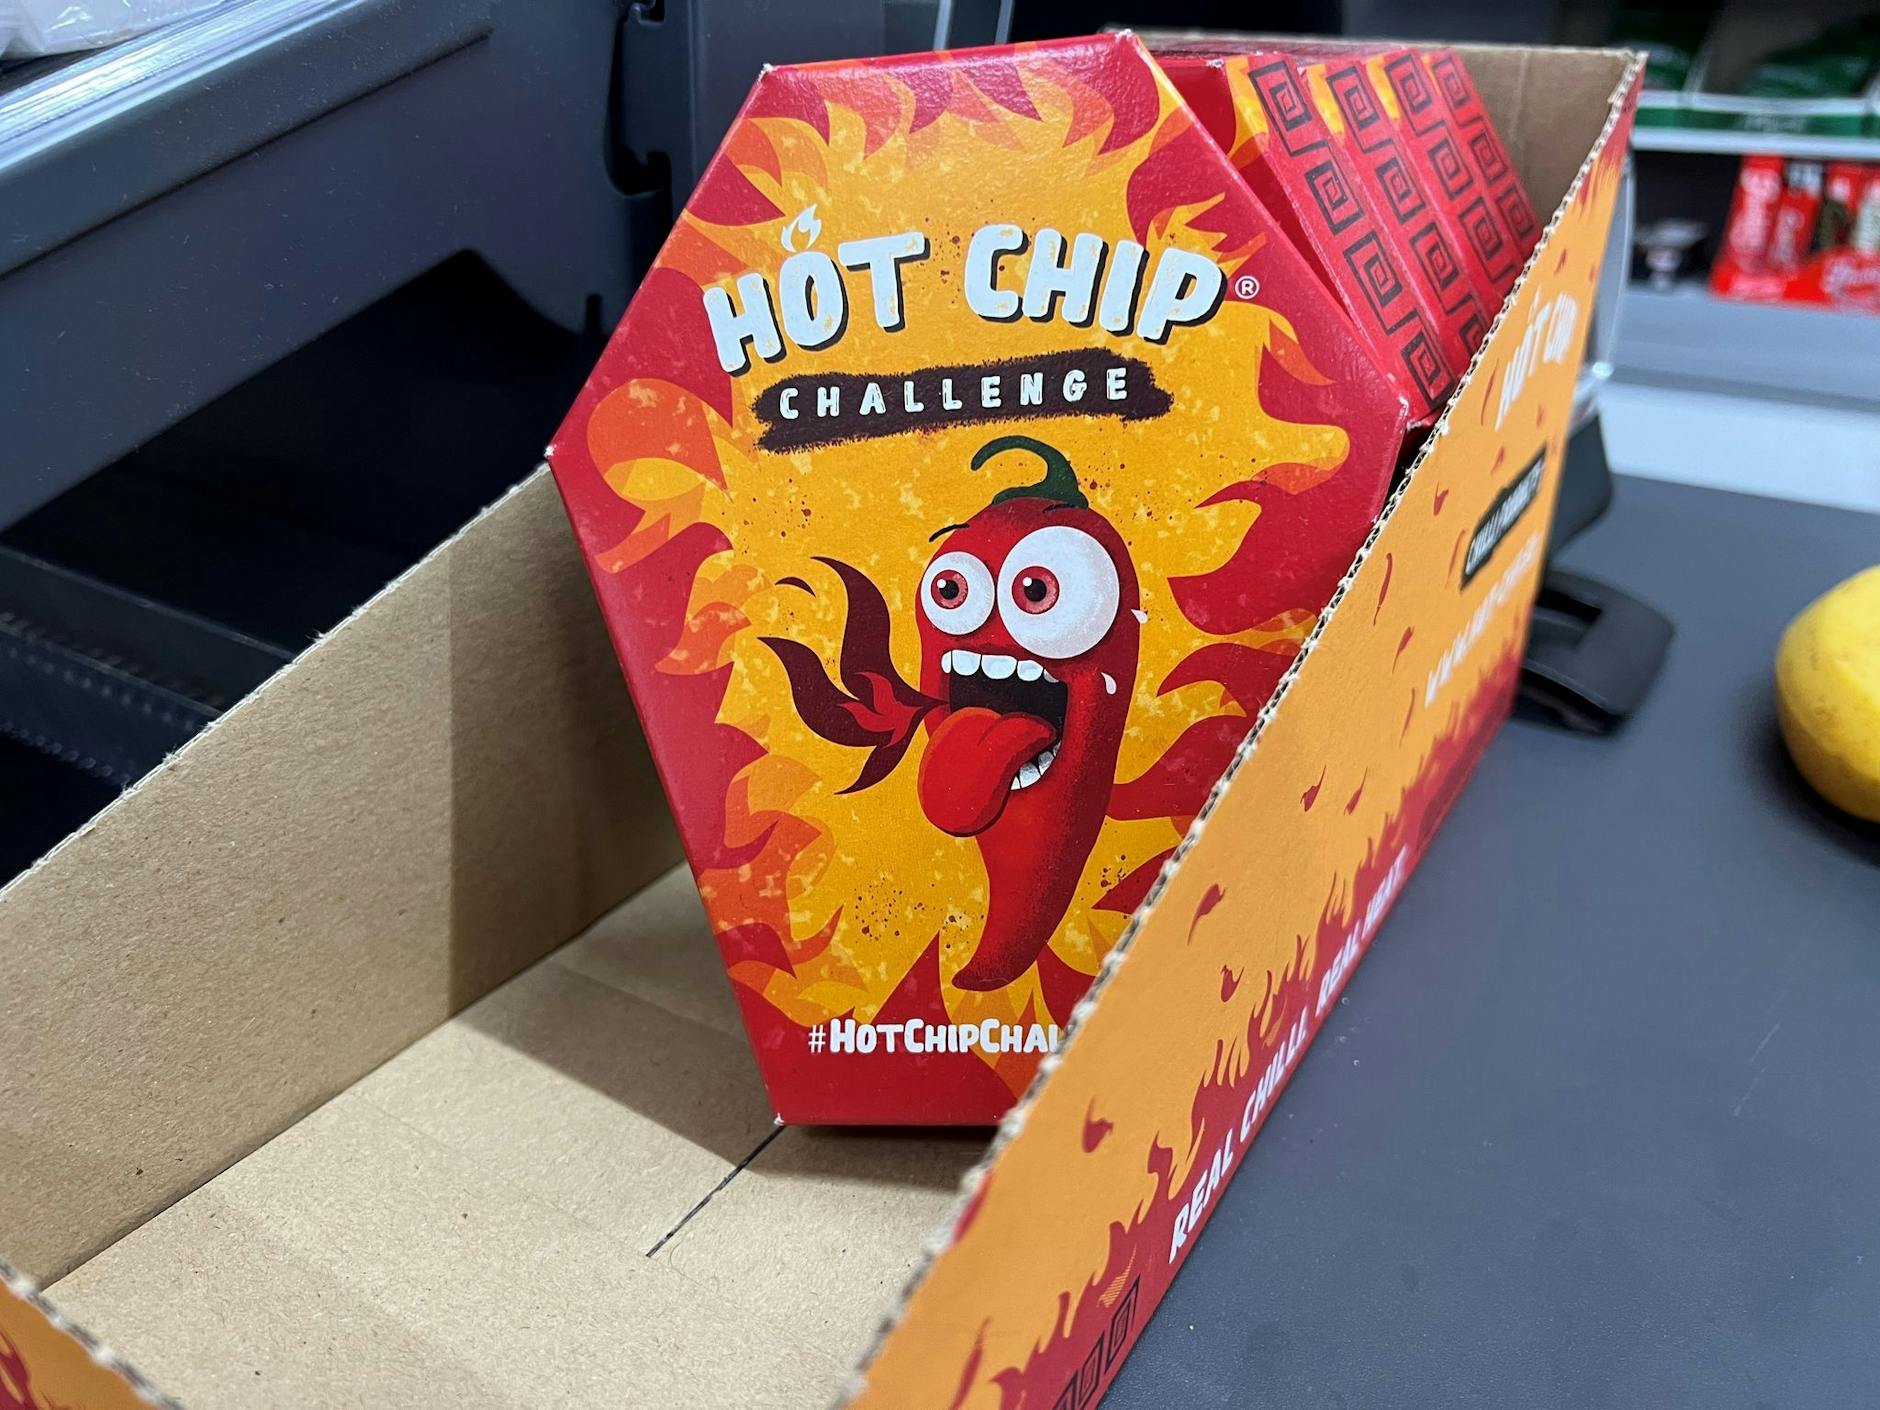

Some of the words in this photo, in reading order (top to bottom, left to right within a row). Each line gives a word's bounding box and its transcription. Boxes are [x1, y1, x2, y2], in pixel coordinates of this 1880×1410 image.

[703, 231, 928, 374] HOT
[963, 223, 1226, 343] CHIP
[779, 367, 1129, 420] CHALLENGE
[807, 1018, 1072, 1054] #HOTCHIPCHAL
[1169, 1128, 1234, 1264] REAL
[1240, 1006, 1308, 1143] CHILL
